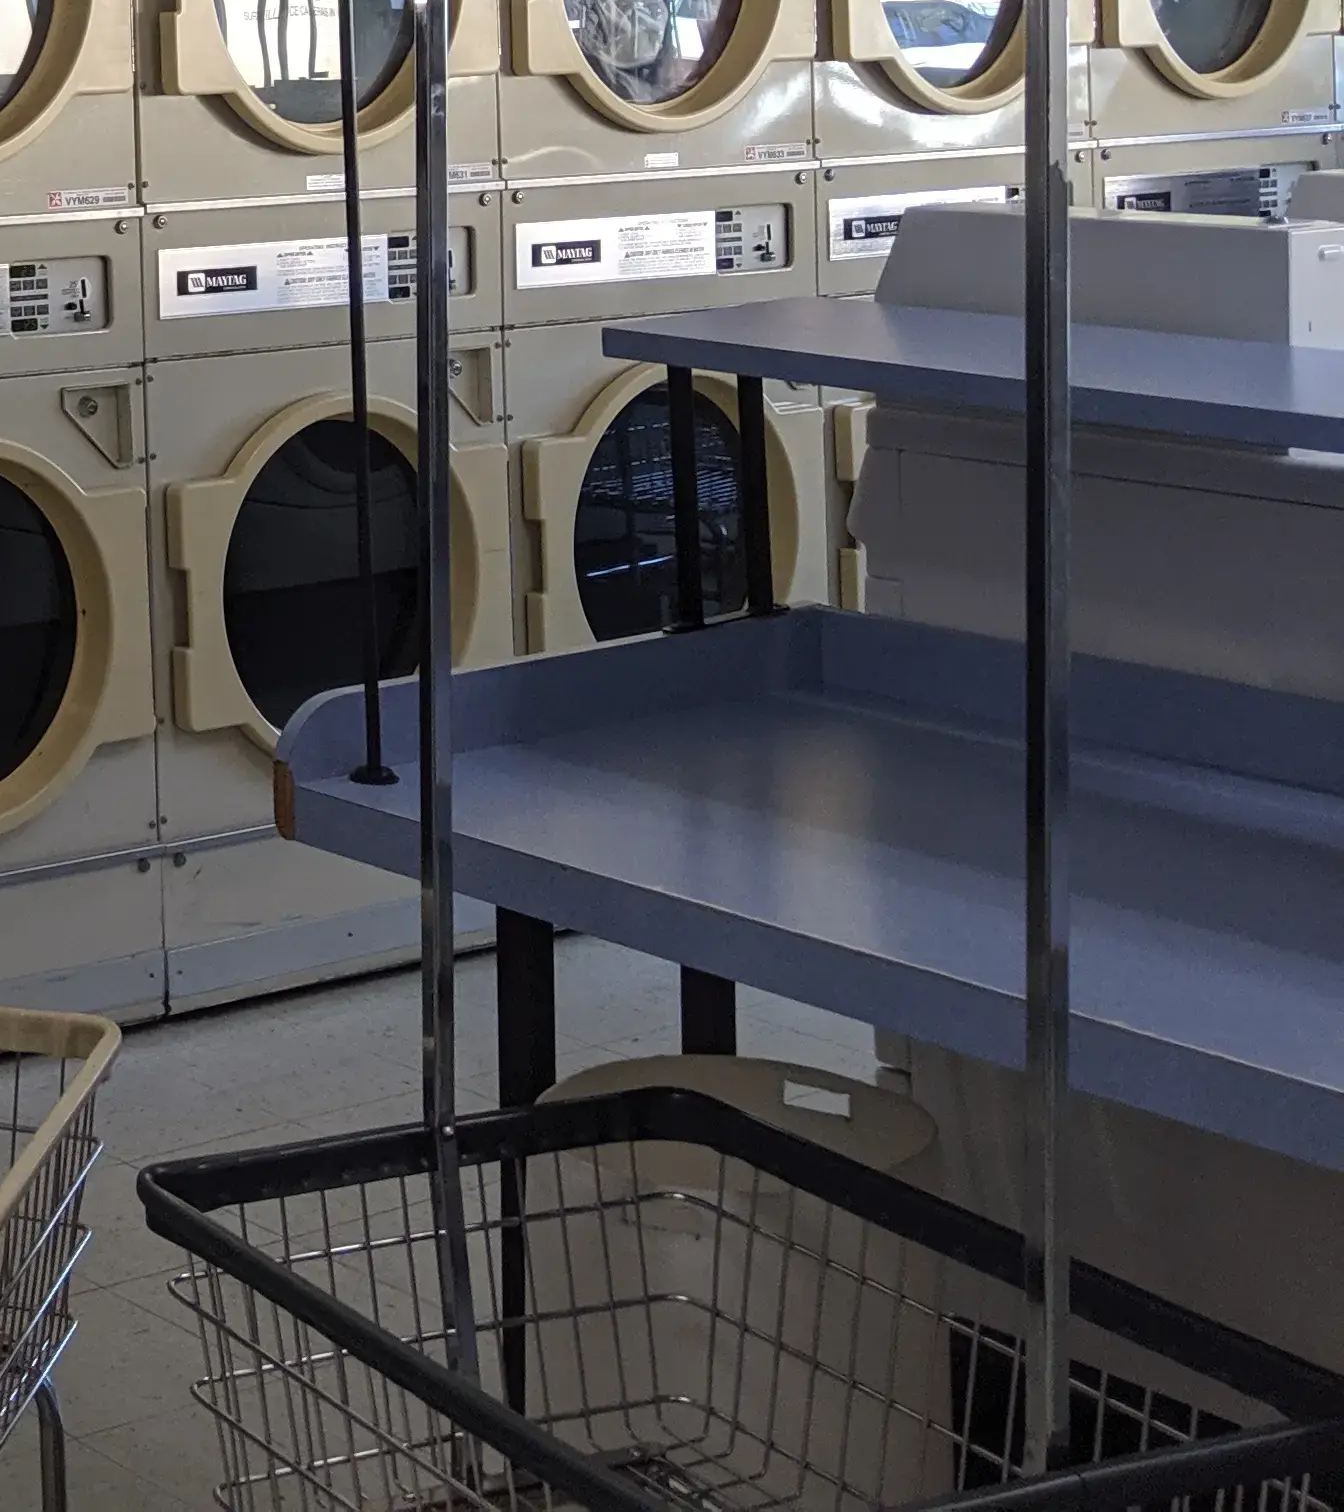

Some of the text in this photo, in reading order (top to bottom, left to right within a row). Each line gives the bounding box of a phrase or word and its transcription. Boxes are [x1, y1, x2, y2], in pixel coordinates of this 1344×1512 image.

[65, 196, 100, 205] VYM629
[557, 246, 592, 260] MAYTAG
[206, 274, 247, 287] MAYTAG
